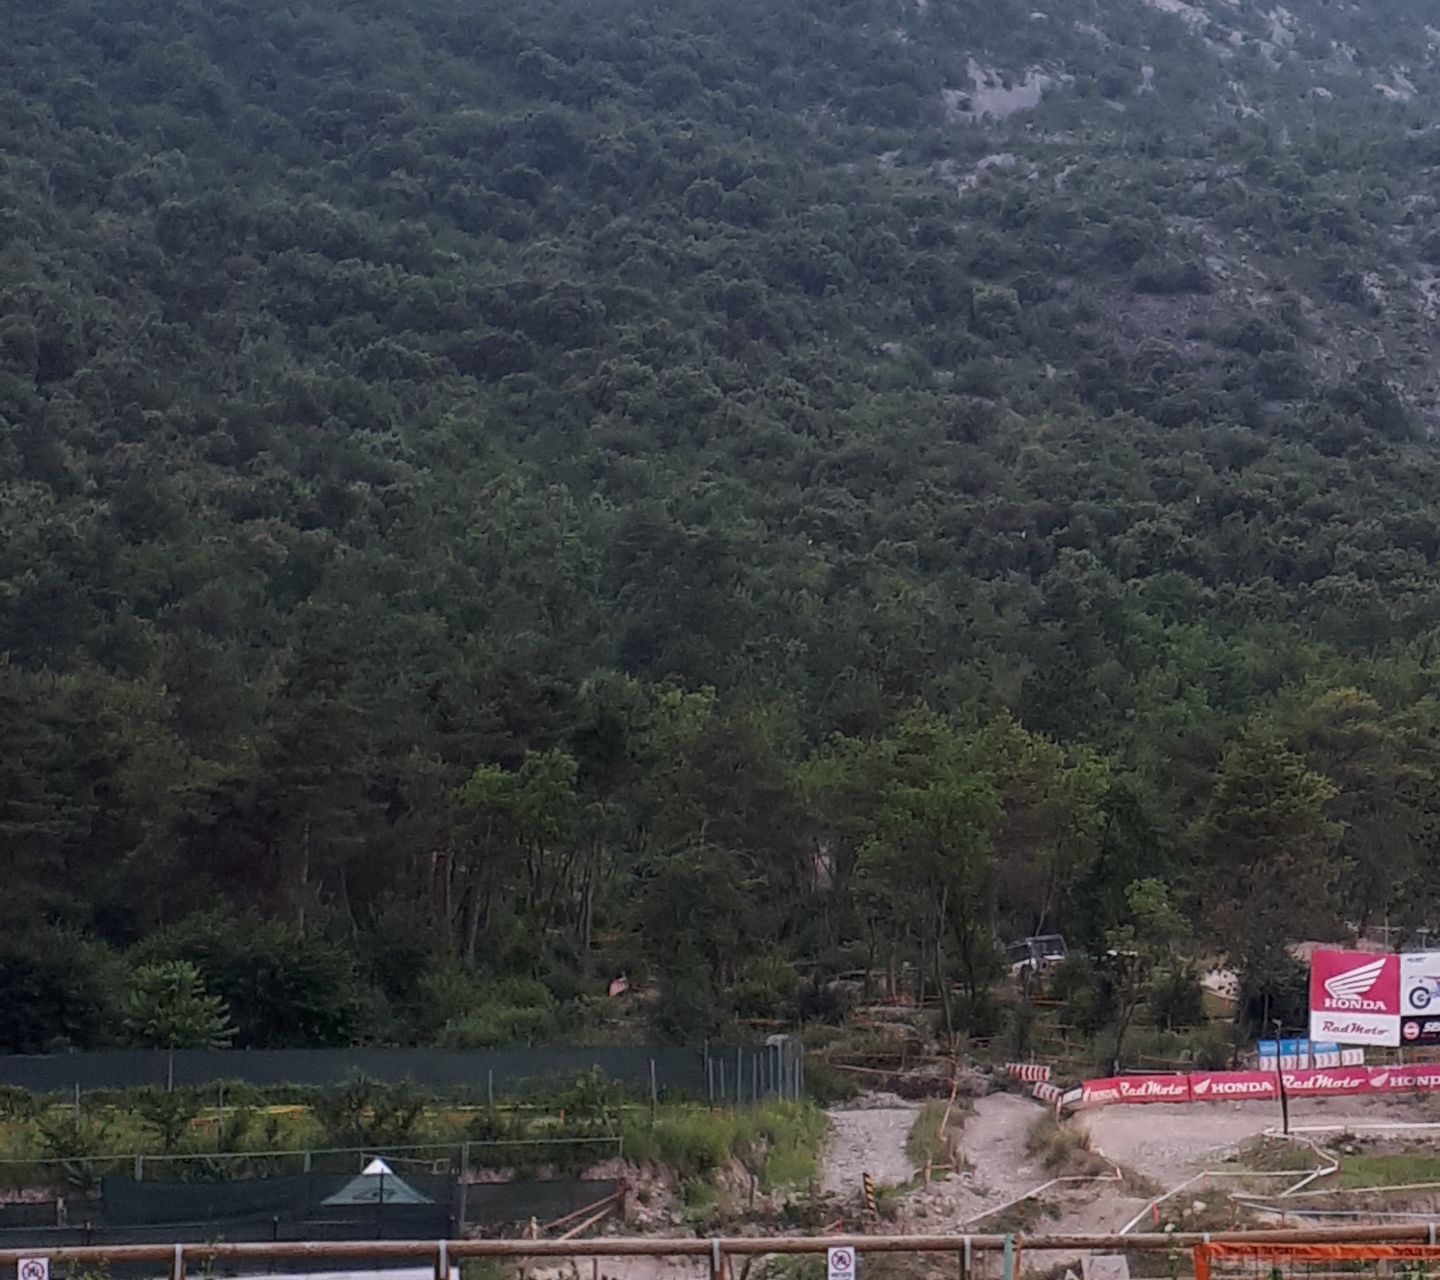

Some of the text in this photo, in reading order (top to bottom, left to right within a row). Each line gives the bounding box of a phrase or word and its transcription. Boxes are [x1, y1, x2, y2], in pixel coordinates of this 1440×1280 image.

[1324, 998, 1387, 1011] HONDA
[1322, 1021, 1390, 1037] RedMoto
[1120, 1080, 1188, 1096] RedMoto
[1211, 1080, 1275, 1093] HONDA
[1282, 1074, 1365, 1090] RedMoto
